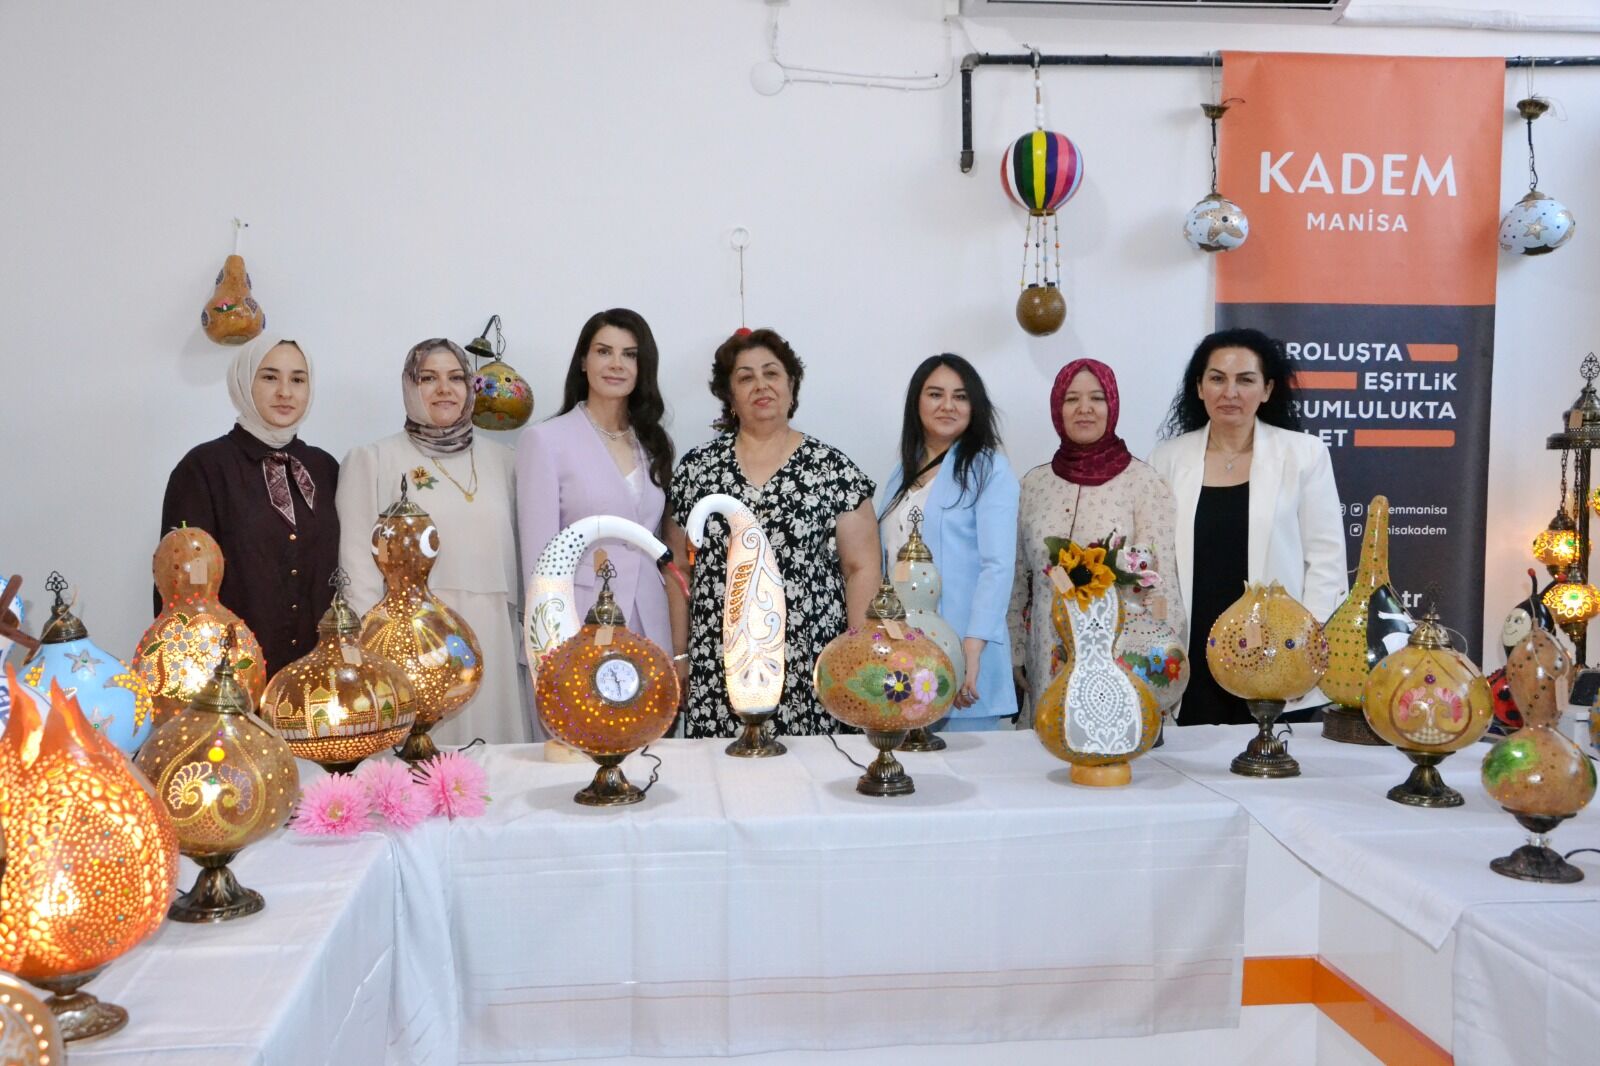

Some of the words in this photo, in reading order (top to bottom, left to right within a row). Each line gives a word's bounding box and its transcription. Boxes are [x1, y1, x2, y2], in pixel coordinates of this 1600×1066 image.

[1259, 151, 1458, 197] KADEM
[1306, 208, 1409, 232] MANİSA
[1285, 342, 1404, 363] ROLUŞTA
[1368, 505, 1448, 515] emmanisa
